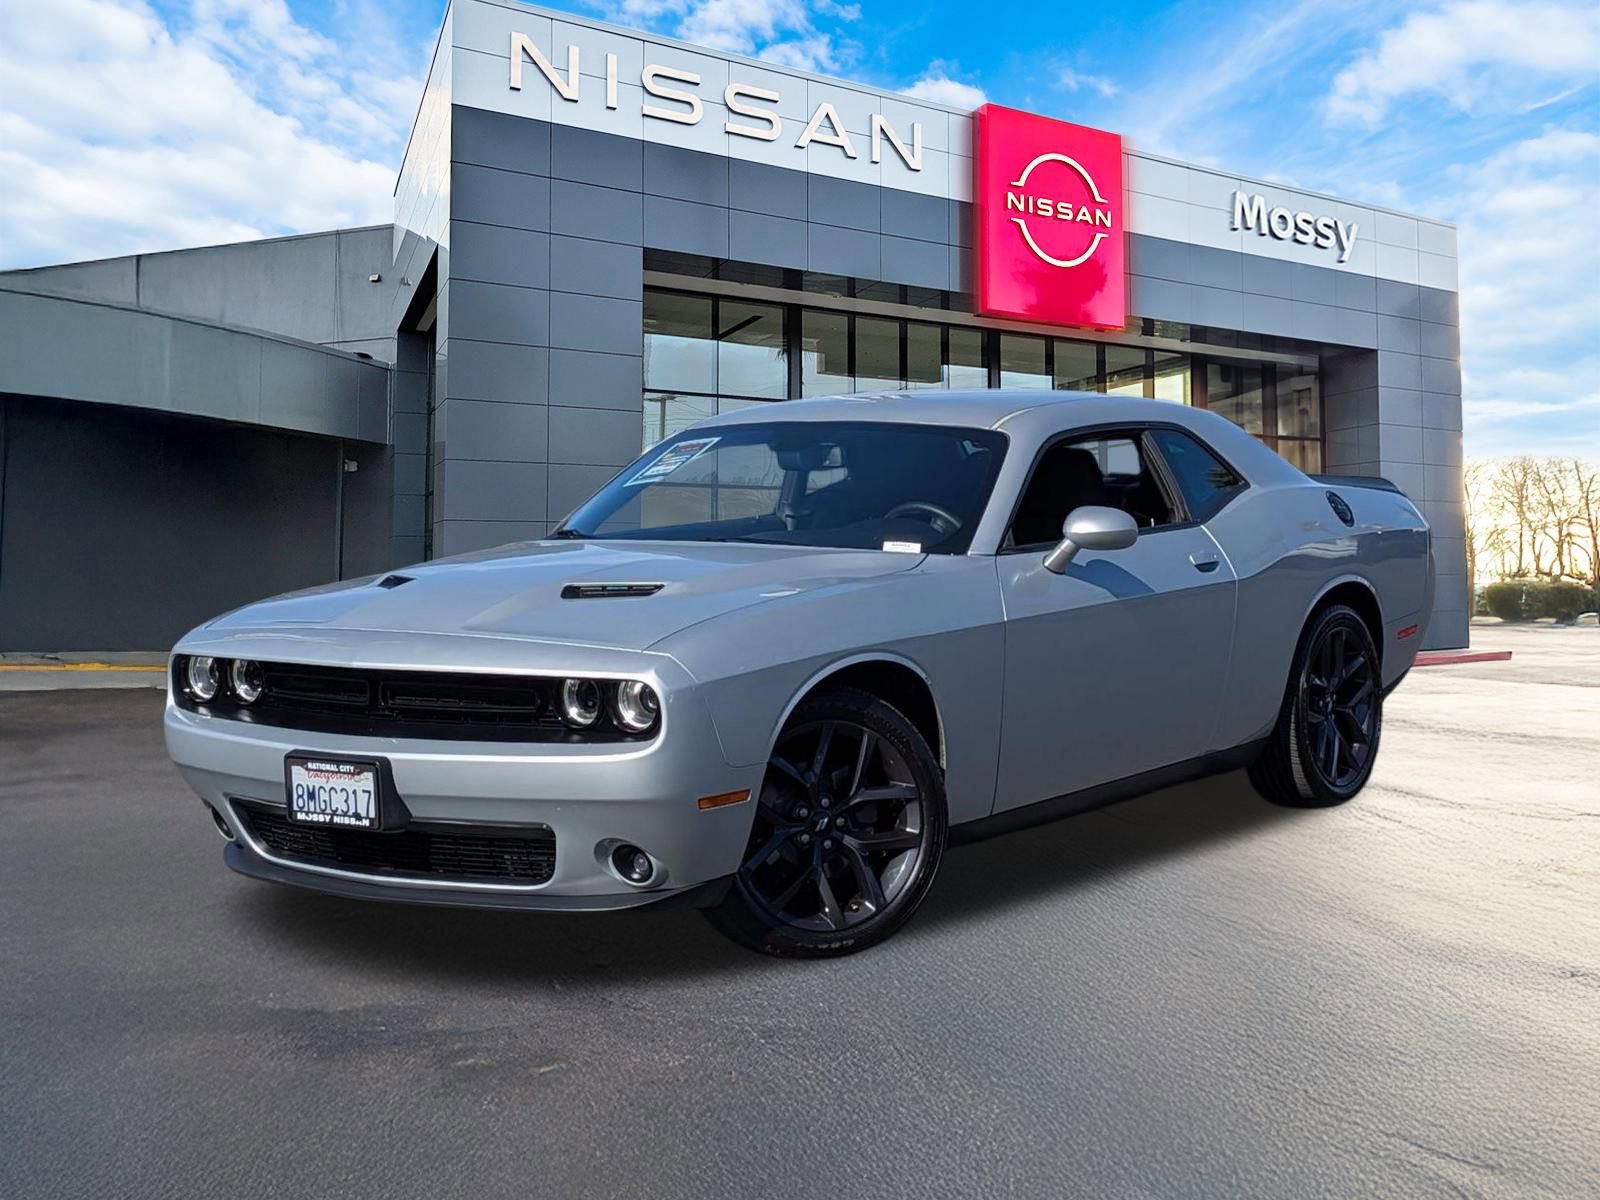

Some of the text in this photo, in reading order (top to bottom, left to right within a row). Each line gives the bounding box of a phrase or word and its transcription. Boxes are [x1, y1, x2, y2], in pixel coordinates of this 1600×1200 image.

[509, 31, 922, 172] NISSAN
[1006, 191, 1112, 228] NISSAN
[1230, 190, 1360, 263] Mossy
[307, 762, 355, 773] NATIONAL CITY
[295, 783, 372, 818] 8MGC317
